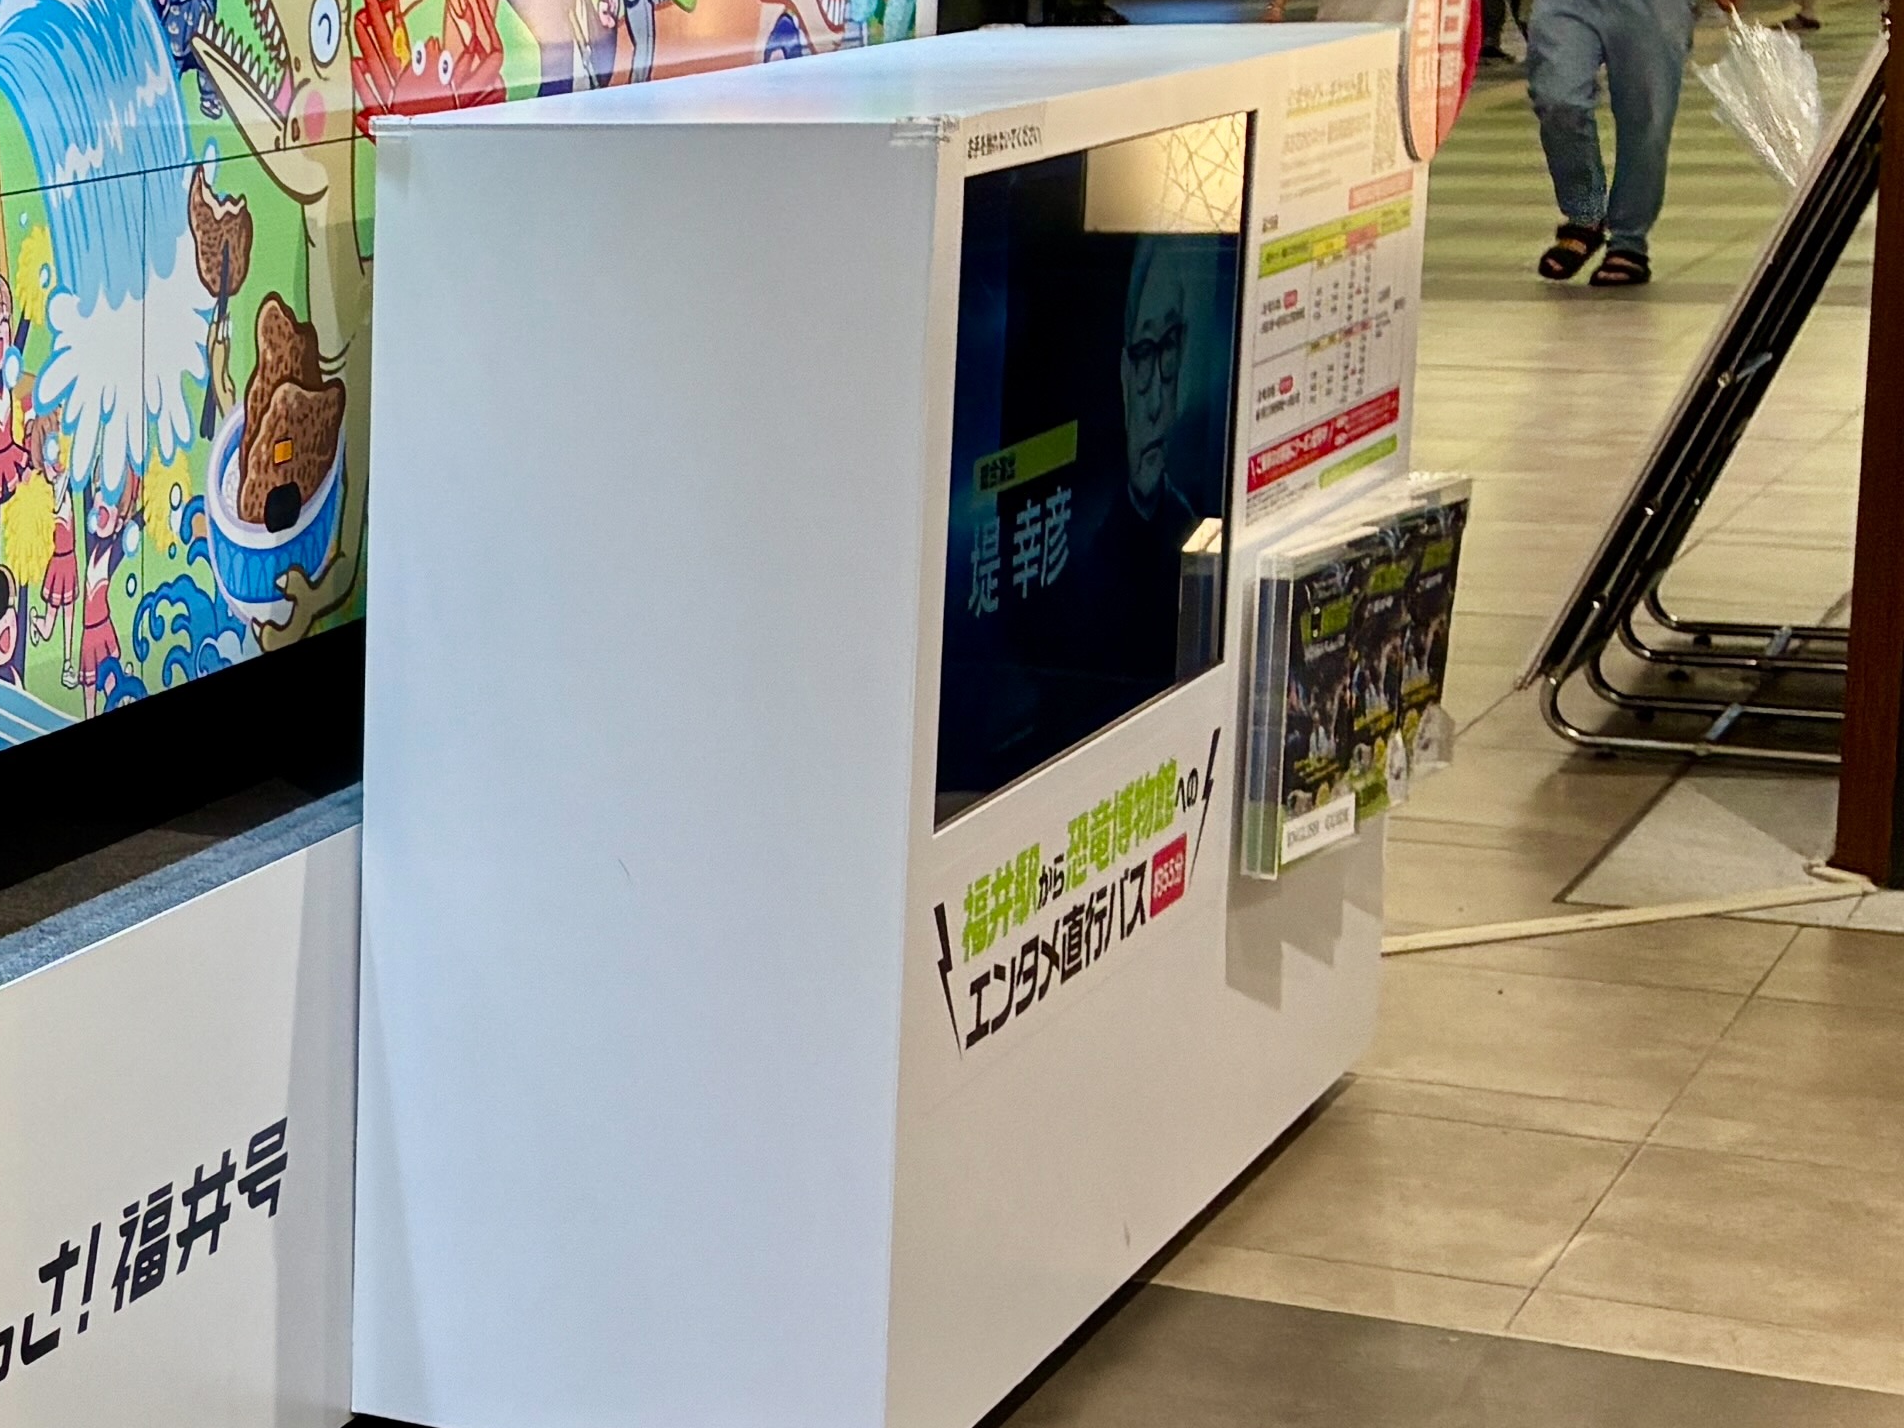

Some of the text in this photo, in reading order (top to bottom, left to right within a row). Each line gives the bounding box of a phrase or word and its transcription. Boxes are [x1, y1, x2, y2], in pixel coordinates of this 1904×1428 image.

[968, 485, 1072, 618] 堤 幸彦
[962, 757, 1198, 963] 福井駅から恐竜博物館への
[965, 859, 1147, 1050] エンタメ直行バス
